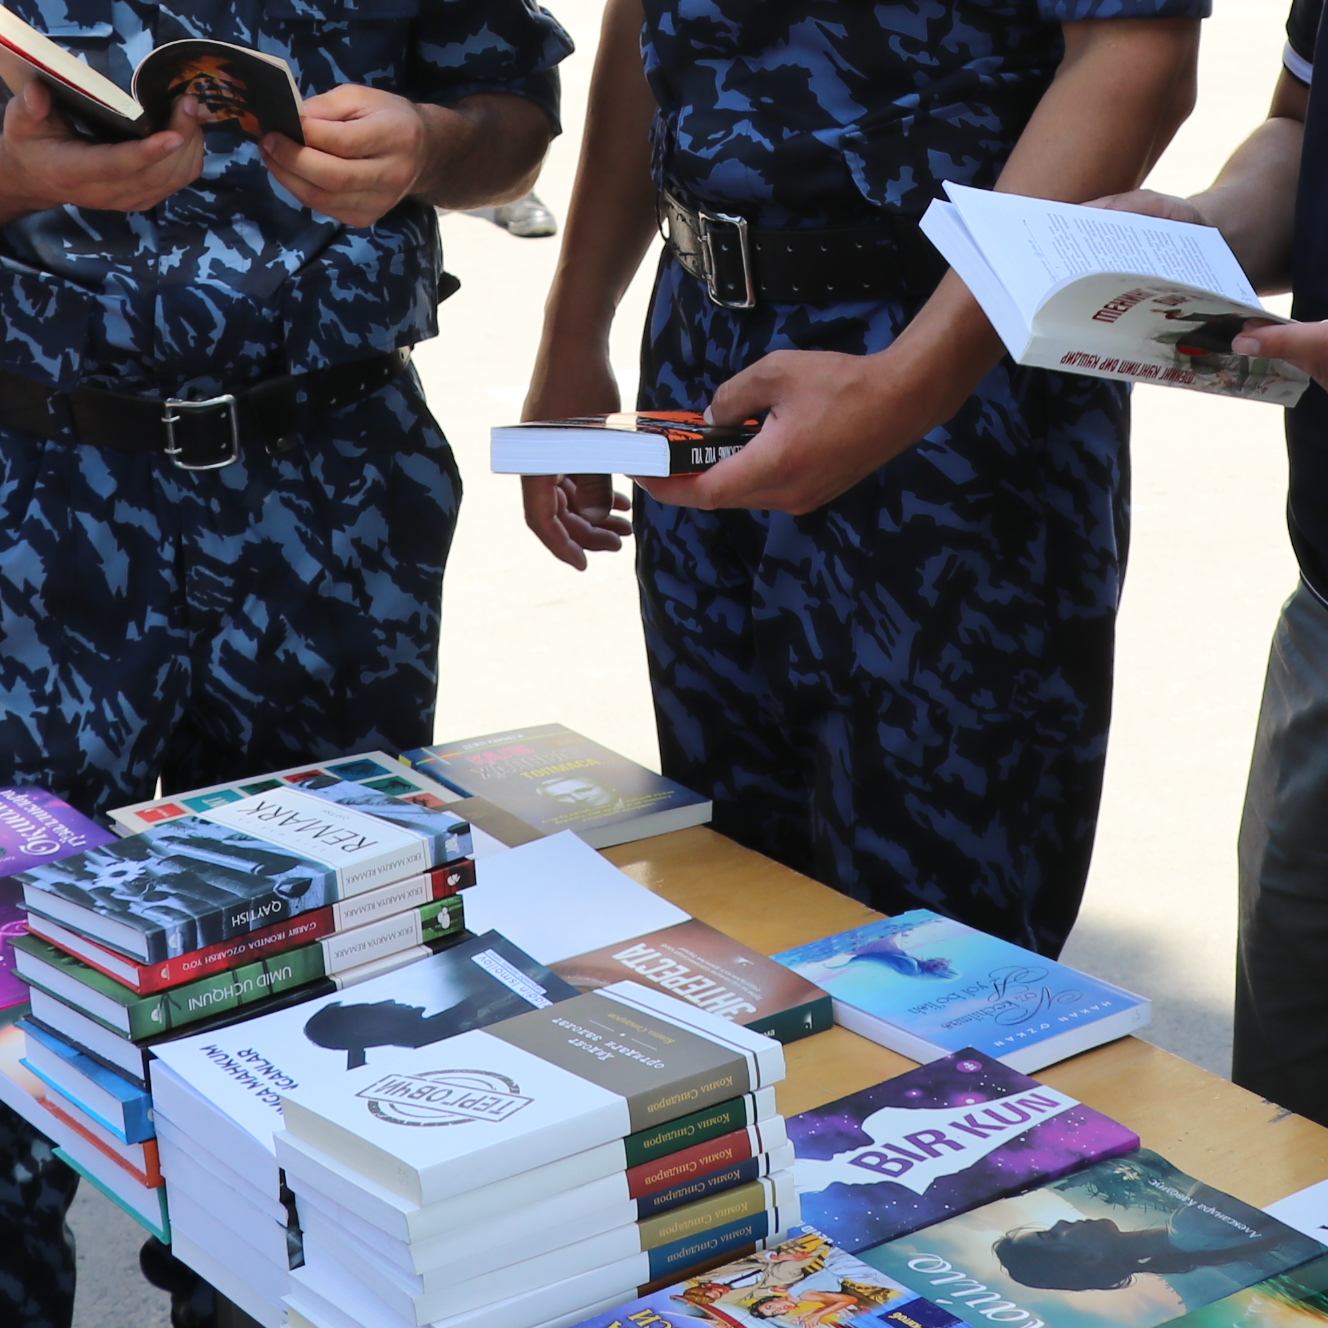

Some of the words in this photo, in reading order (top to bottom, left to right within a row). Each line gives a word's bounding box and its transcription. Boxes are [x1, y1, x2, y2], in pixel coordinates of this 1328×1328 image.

[236, 799, 377, 850] REMARK
[344, 867, 377, 885] REMARK
[230, 898, 282, 926] QAYTISH
[343, 901, 376, 919] REMARK
[247, 931, 285, 949] FRONTDA
[333, 941, 366, 959] REMARK
[255, 964, 292, 990] UMID
[188, 975, 252, 1012] UCHQUNI
[1057, 998, 1112, 1023] HAKAN
[198, 1043, 264, 1089] MAHKUM
[699, 1075, 733, 1094] Комил
[646, 1087, 699, 1113] Синдаров
[697, 1112, 730, 1131] Комил
[642, 1124, 695, 1149] Синдаров
[846, 1124, 966, 1179] BIR
[949, 1093, 1062, 1141] KUN
[698, 1147, 732, 1167] Комил
[643, 1160, 697, 1185] Синдаров
[707, 1168, 740, 1187] Комил
[652, 1181, 705, 1206] Синдаров
[714, 1201, 748, 1220] Комил
[1197, 1202, 1262, 1239] Александра
[658, 1213, 713, 1238] Синдаров
[720, 1225, 752, 1243] Комил
[666, 1237, 719, 1263] Синдаров
